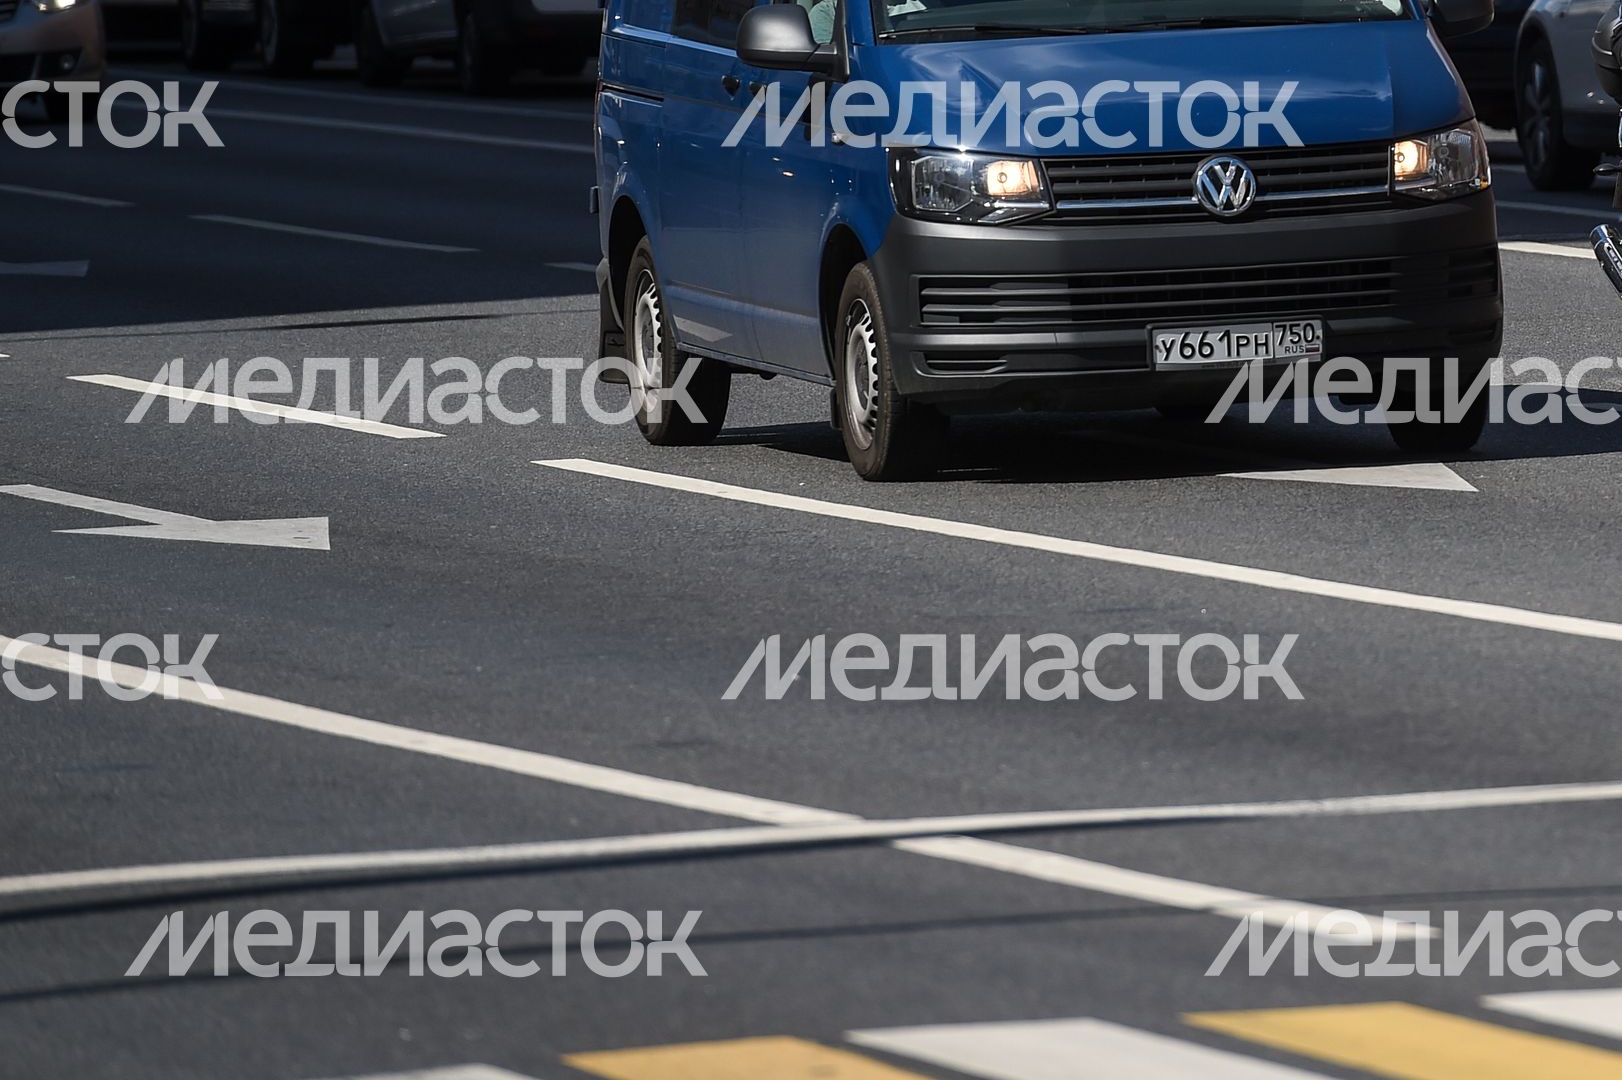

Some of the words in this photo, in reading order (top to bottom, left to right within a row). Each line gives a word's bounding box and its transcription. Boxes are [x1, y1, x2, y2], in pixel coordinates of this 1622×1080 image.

[1160, 329, 1269, 361] У661РН
[1274, 322, 1316, 347] 750
[1284, 345, 1305, 354] RUS
